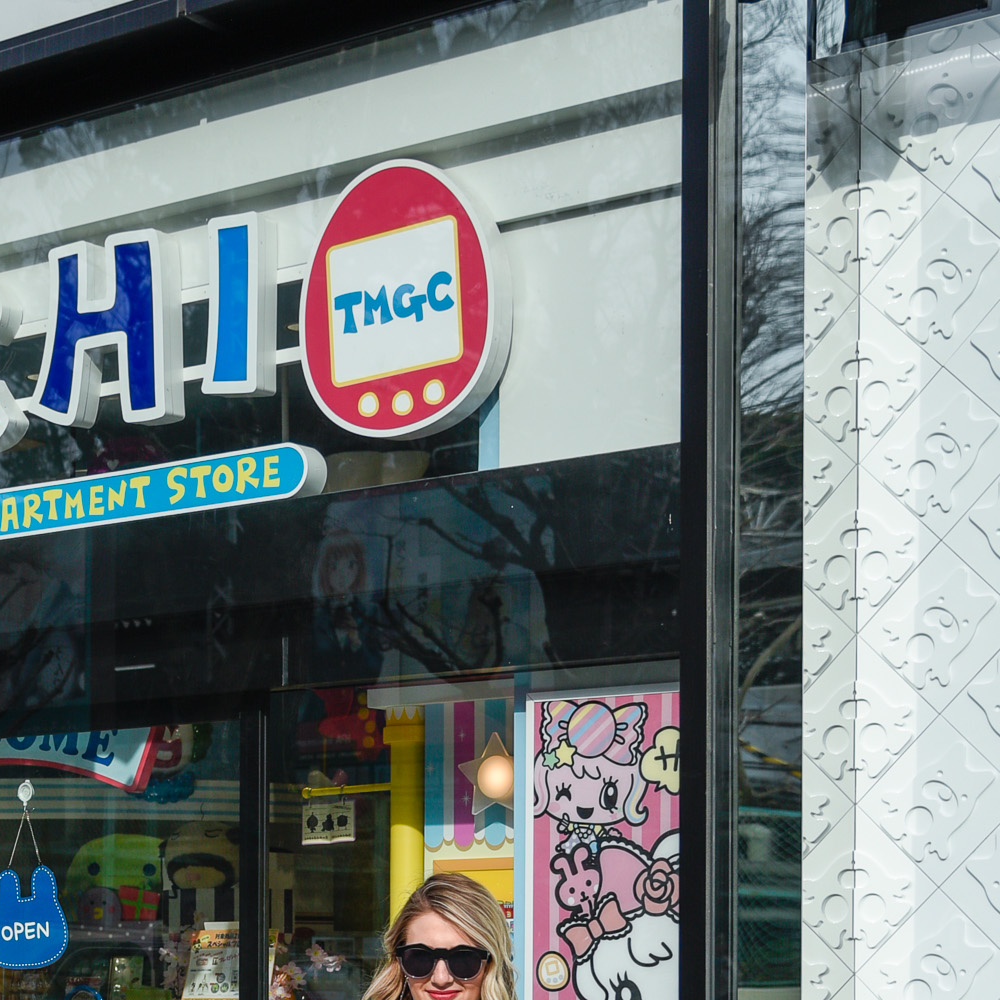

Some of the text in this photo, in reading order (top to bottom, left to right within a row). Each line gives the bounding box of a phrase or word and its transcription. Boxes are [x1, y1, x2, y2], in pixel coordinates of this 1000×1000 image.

[335, 270, 455, 335] TMGC
[168, 453, 282, 505] STORE
[1, 921, 50, 942] OPEN
